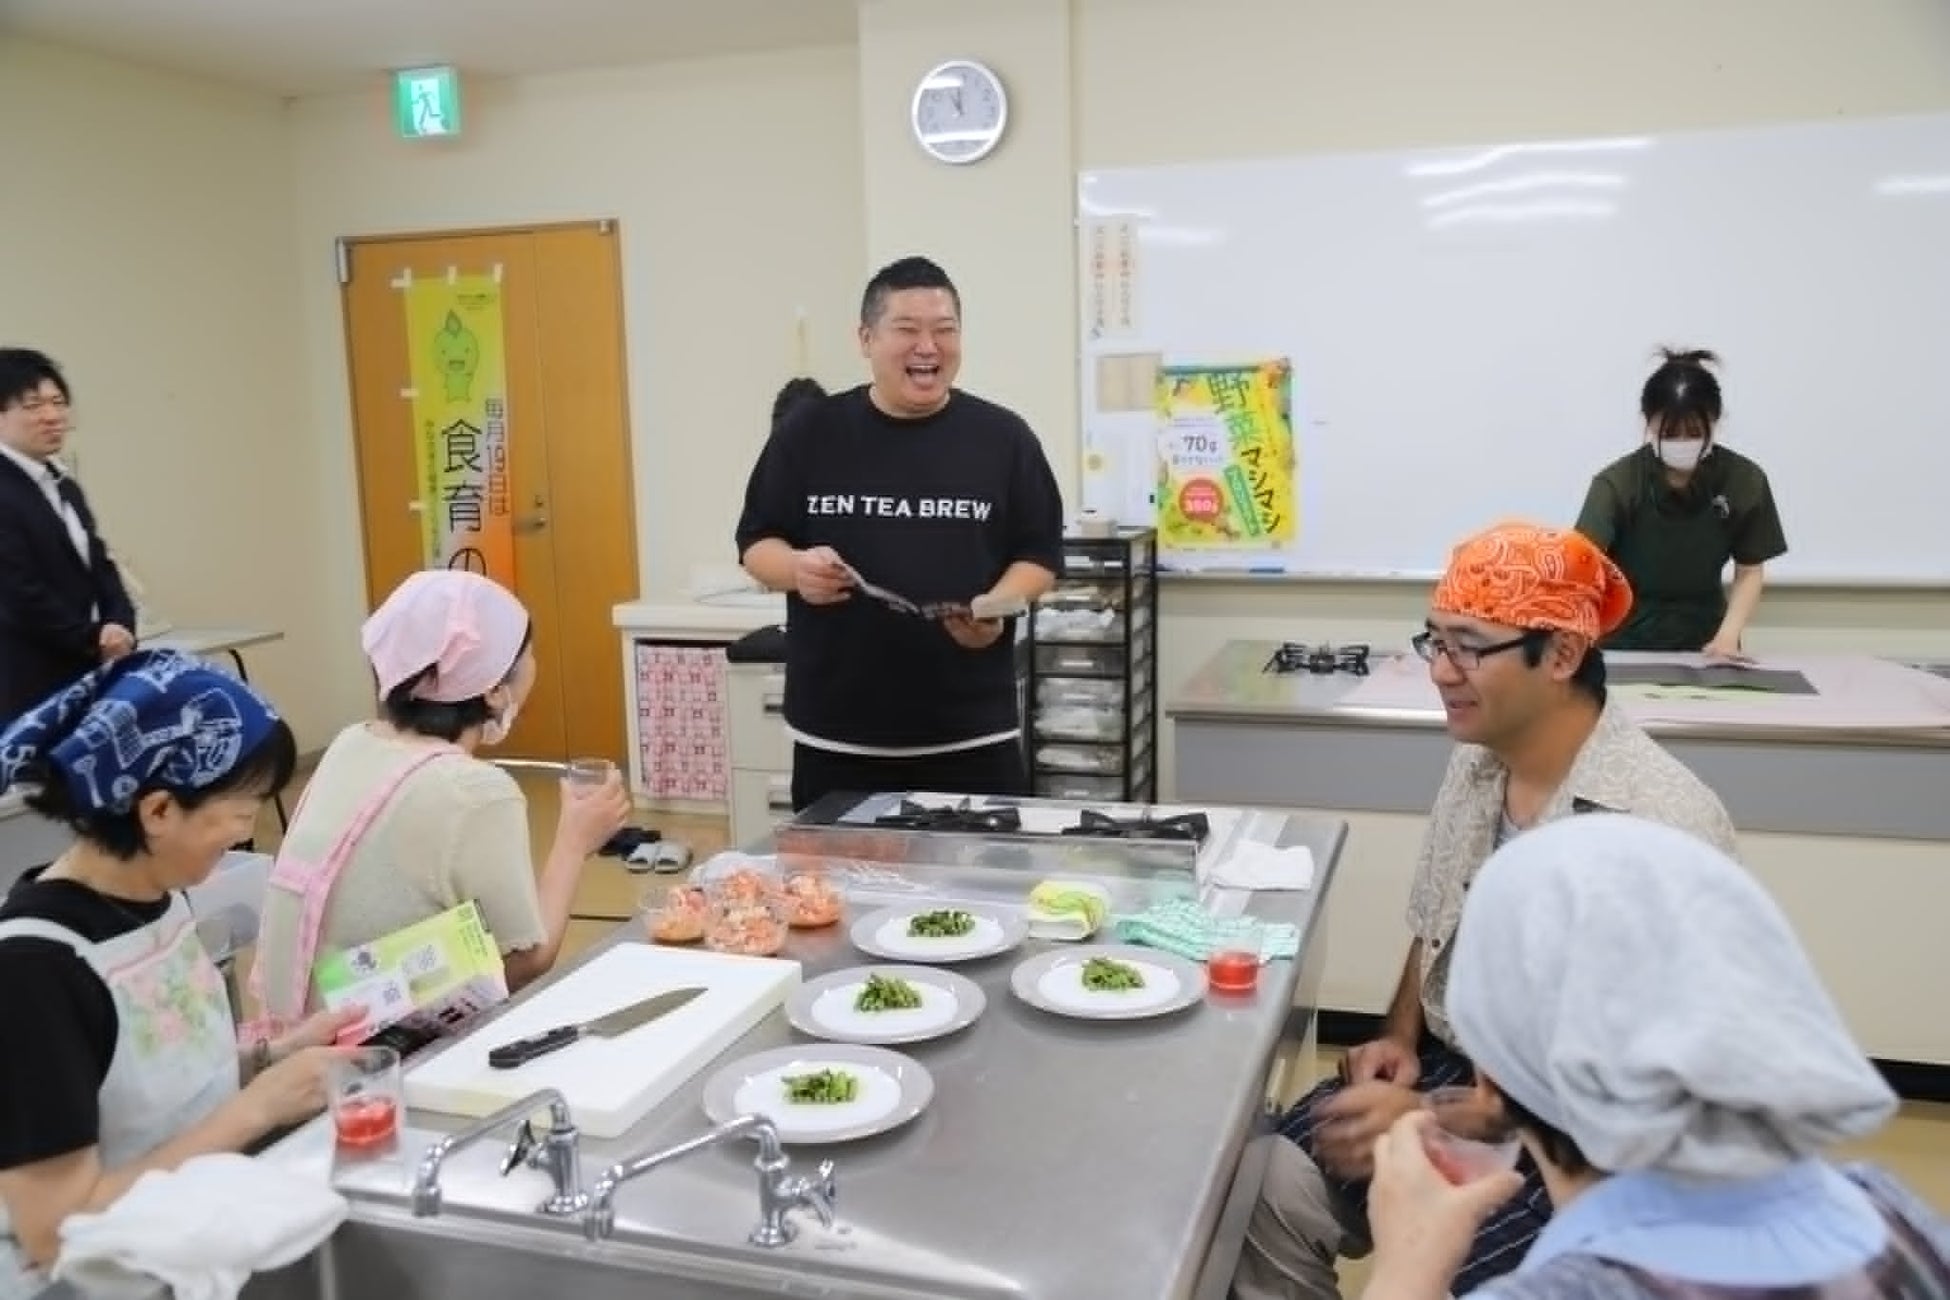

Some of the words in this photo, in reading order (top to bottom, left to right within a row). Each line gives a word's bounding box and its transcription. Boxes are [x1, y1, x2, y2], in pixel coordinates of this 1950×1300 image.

[807, 495, 854, 515] ZEN
[860, 496, 911, 517] TEA
[919, 499, 992, 521] BREW
